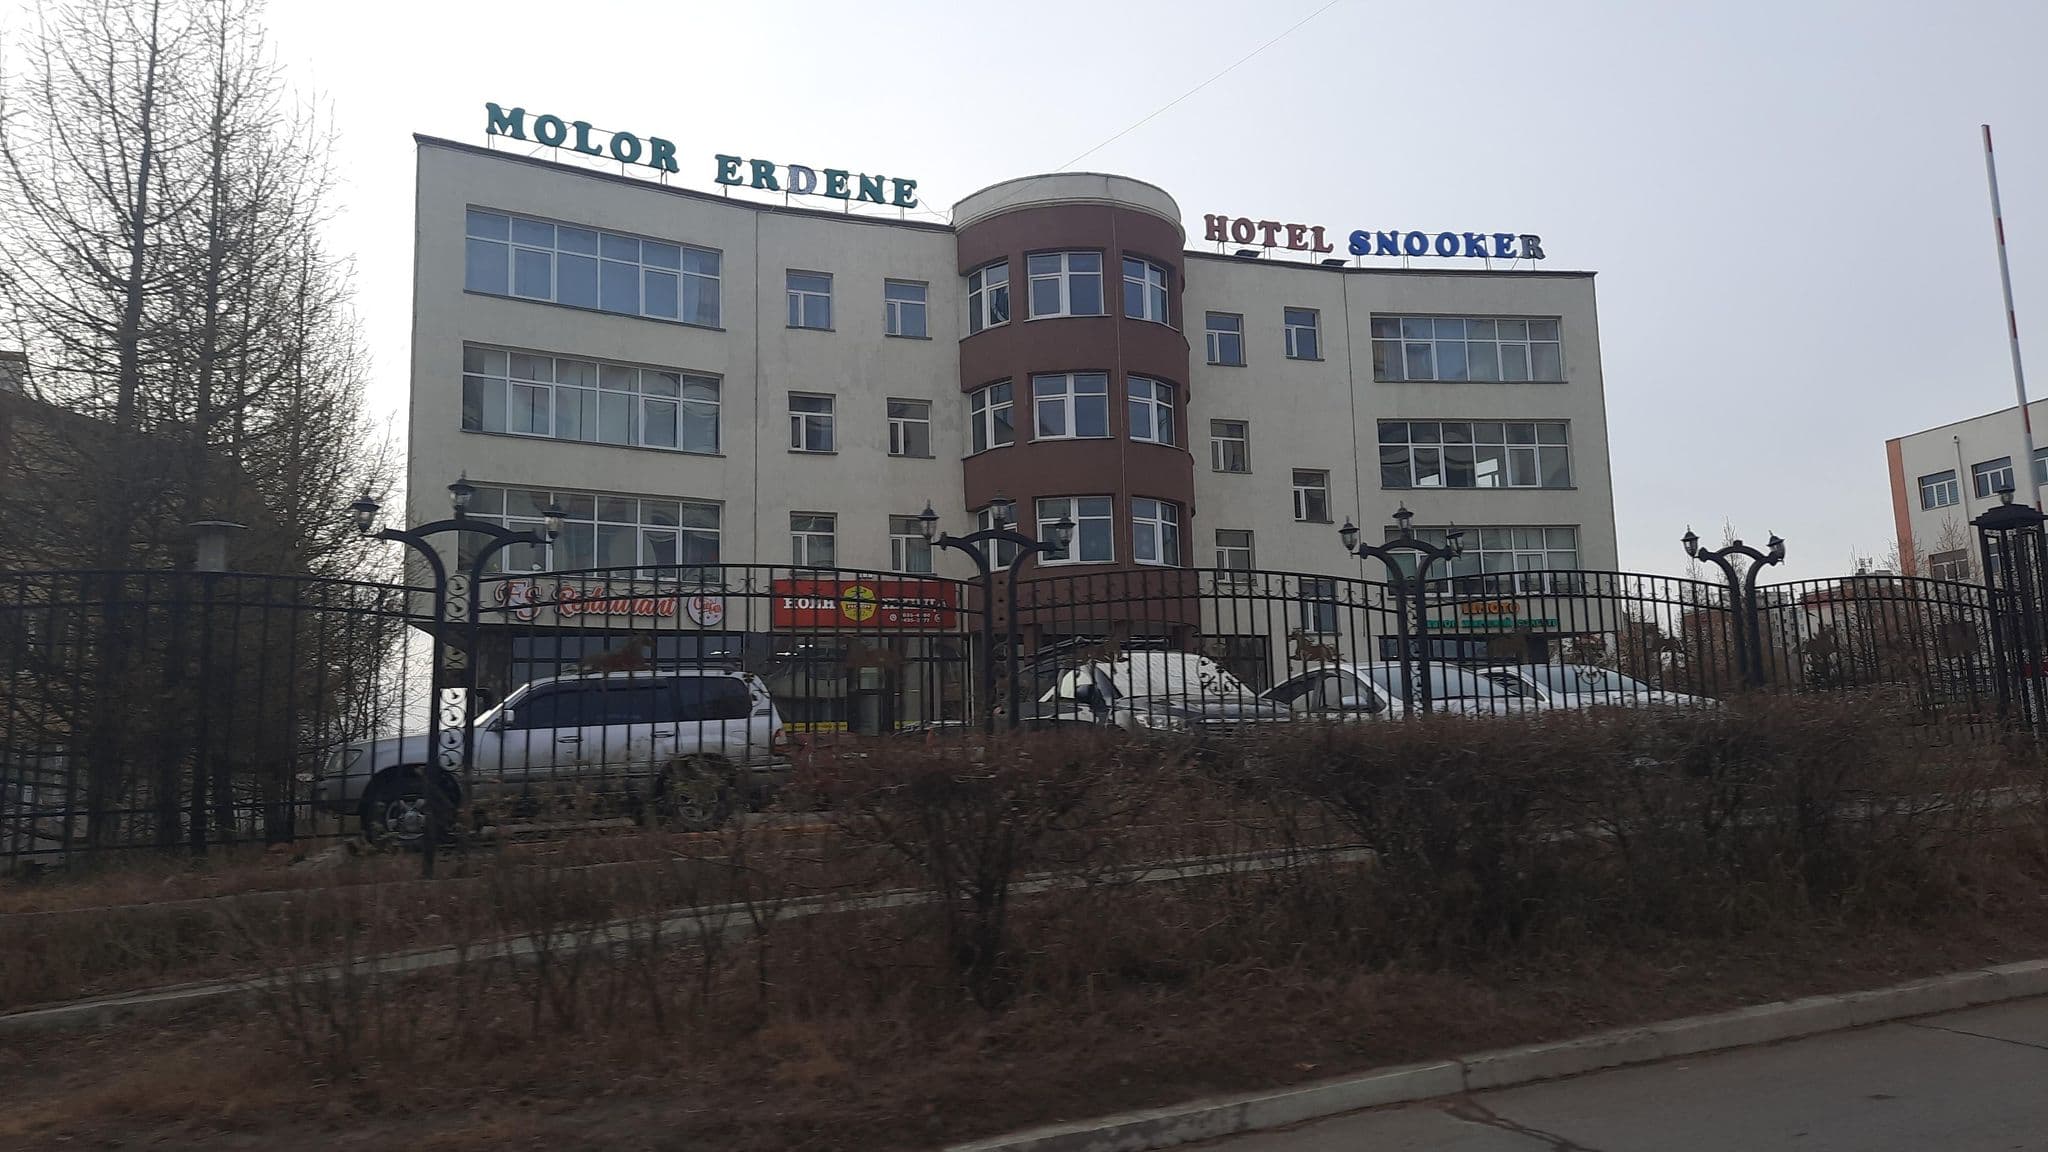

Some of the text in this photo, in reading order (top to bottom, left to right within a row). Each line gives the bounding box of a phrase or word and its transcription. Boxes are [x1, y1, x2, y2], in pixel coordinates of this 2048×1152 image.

[486, 103, 918, 208] MOLOR ERDENE
[1204, 214, 1545, 259] HOTEL SNOOKER
